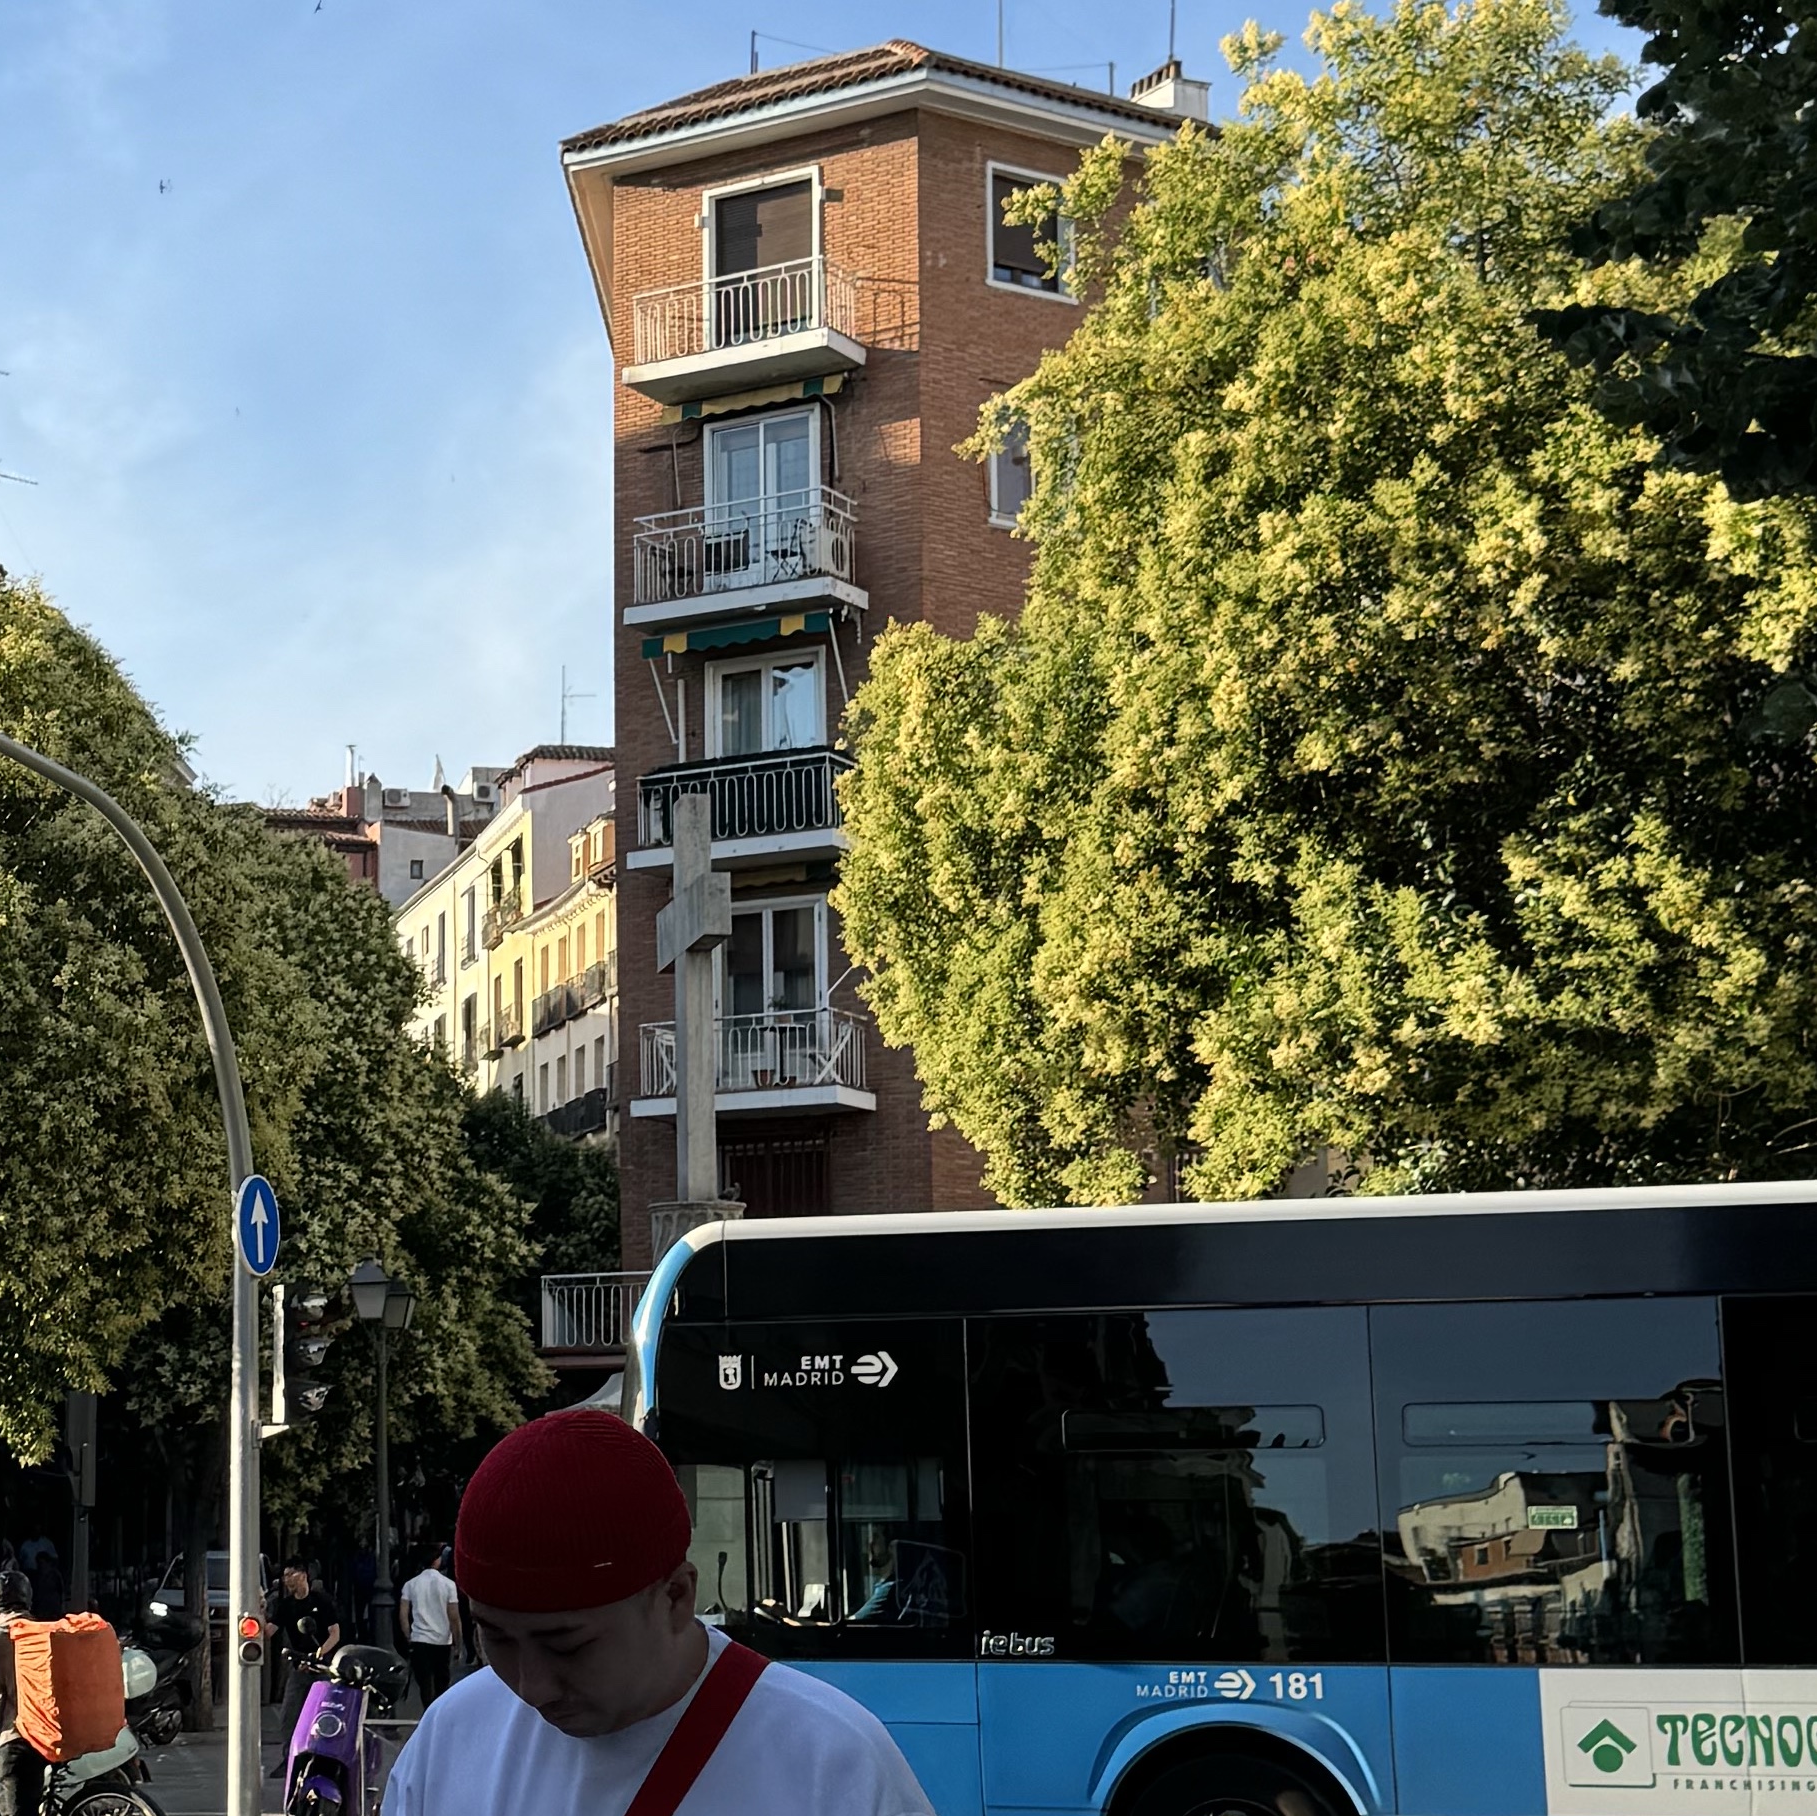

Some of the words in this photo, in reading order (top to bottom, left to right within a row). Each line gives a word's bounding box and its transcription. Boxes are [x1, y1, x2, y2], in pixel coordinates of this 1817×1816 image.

[801, 1355, 844, 1370] EMT
[764, 1371, 845, 1387] MADRID
[1169, 1671, 1208, 1685] EMT
[1136, 1684, 1208, 1699] MADRID
[1269, 1672, 1324, 1700] 181
[1673, 1778, 1816, 1792] FRANCHISING
